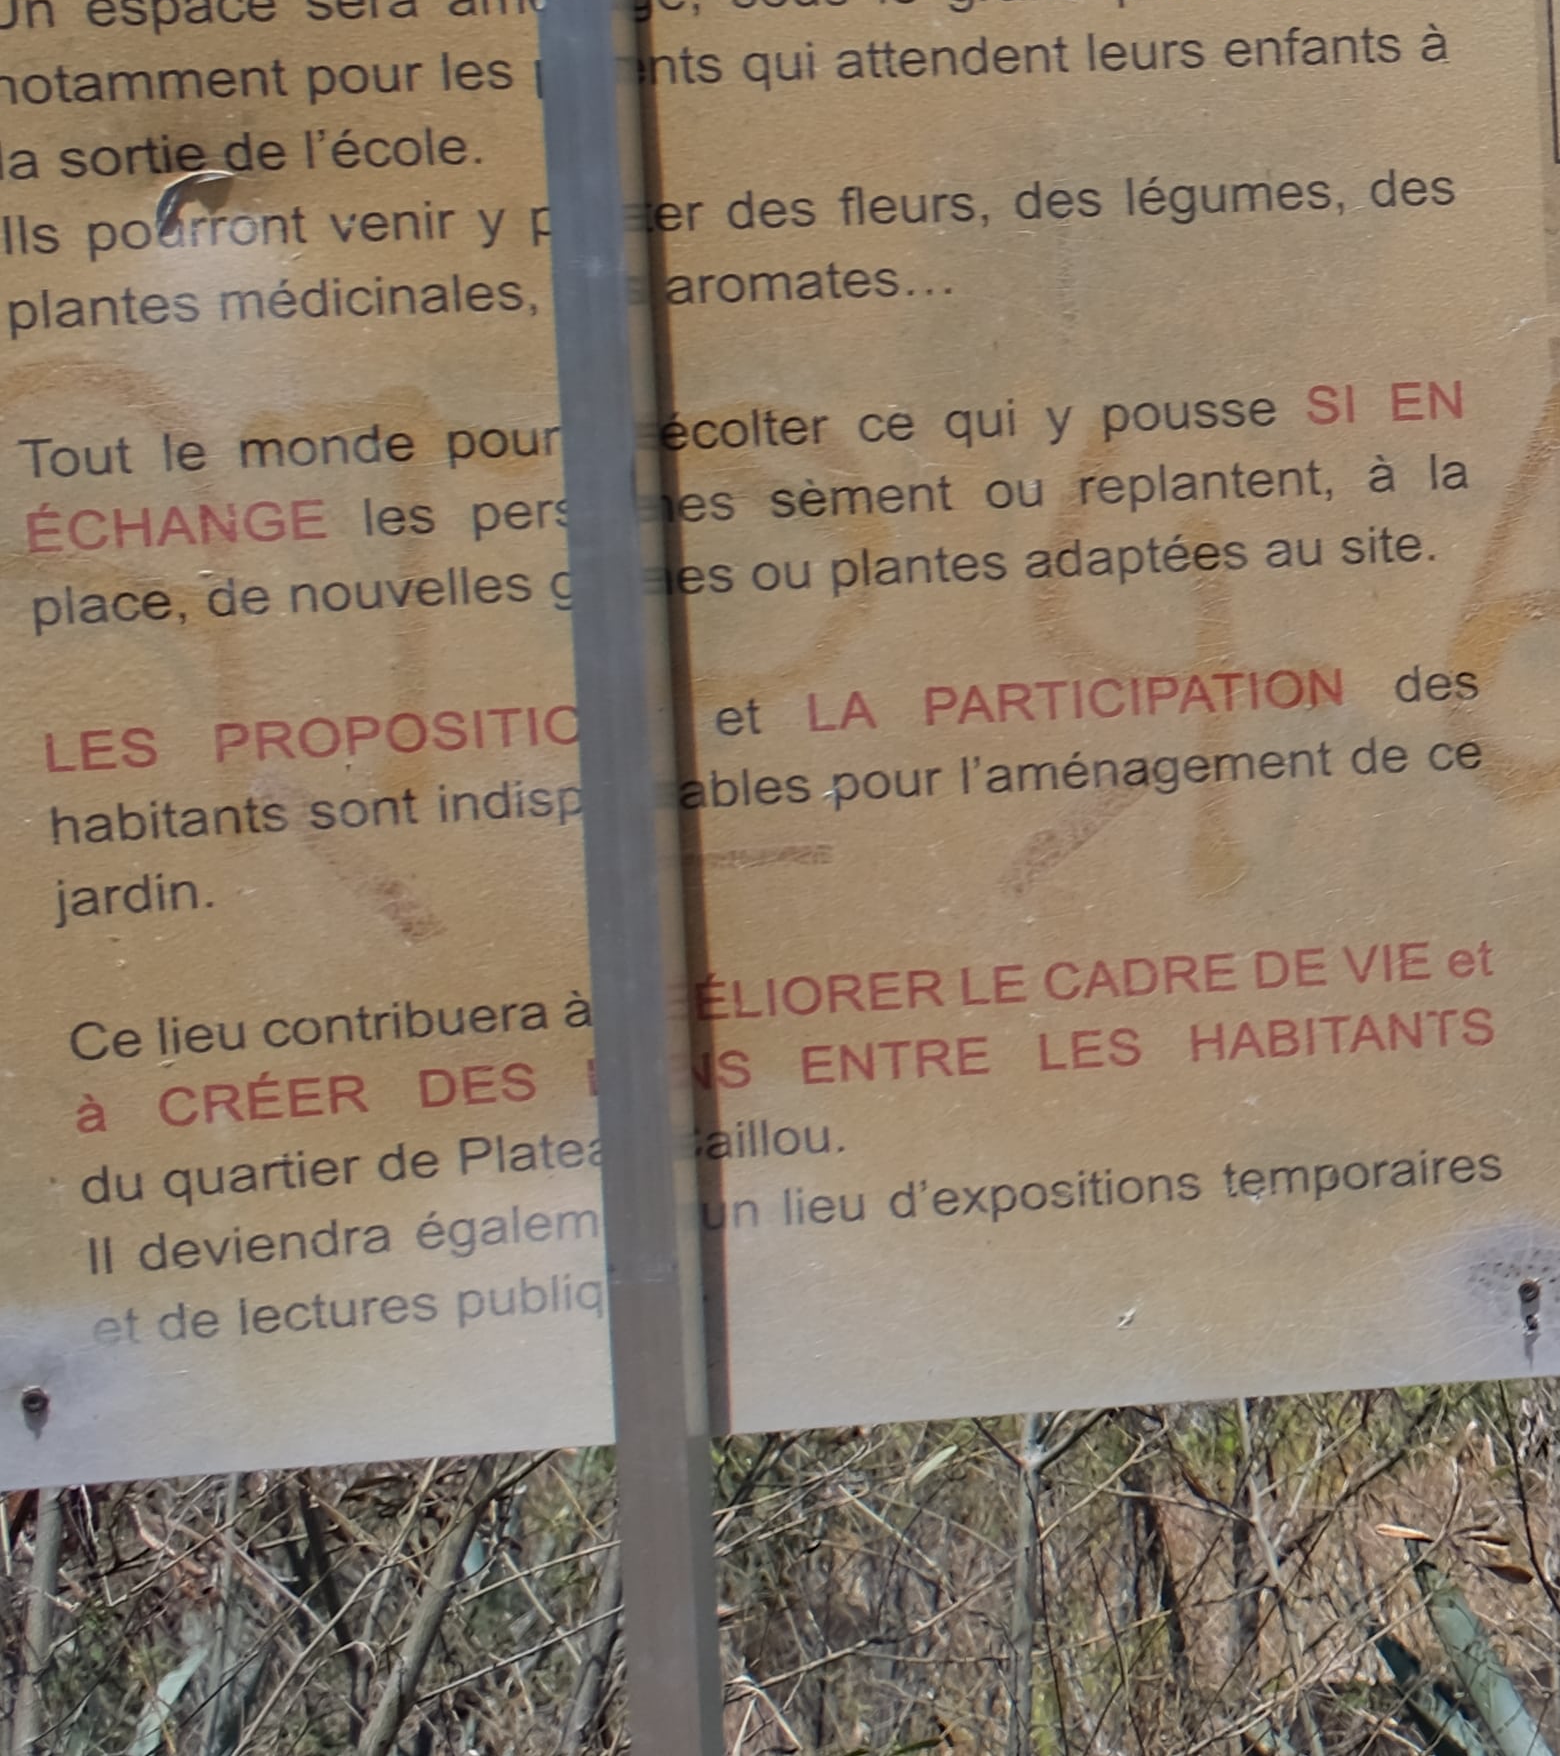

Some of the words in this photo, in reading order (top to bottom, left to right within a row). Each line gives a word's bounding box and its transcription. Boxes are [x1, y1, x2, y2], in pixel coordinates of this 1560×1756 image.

[307, 63, 423, 105] pour
[442, 52, 514, 91] les
[742, 41, 815, 92] qui
[836, 36, 1069, 79] attendent
[1088, 33, 1205, 71] leurs
[1224, 26, 1402, 68] enfants
[1421, 23, 1450, 64] à
[59, 134, 211, 178] sortie
[224, 132, 287, 172] de
[3, 215, 60, 255] Ils
[87, 202, 306, 262] pourront
[330, 201, 456, 243] venir
[478, 208, 505, 249] y
[727, 190, 816, 230] des
[838, 186, 989, 228] fleurs,
[1015, 181, 1102, 219] des
[1126, 176, 1344, 225] légumes,
[1370, 168, 1456, 208] des
[8, 287, 200, 340] plantes
[220, 274, 537, 320] médicinales,
[16, 437, 133, 478] Tout
[163, 432, 206, 471] le
[240, 424, 415, 468] monde
[859, 413, 915, 442] ce
[945, 398, 1016, 448] qui
[1046, 406, 1072, 445] y
[1103, 398, 1276, 443] pousse
[1307, 385, 1354, 425] SI
[1391, 380, 1463, 421] EN
[27, 499, 328, 555] ÉCHANGE
[364, 498, 435, 536] les
[769, 475, 955, 518] sèment
[986, 479, 1043, 509] ou
[1075, 460, 1332, 512] replantent,
[1369, 454, 1395, 493] à
[1430, 453, 1469, 490] la
[33, 583, 187, 636] place,
[202, 574, 270, 617] de
[291, 566, 532, 613] nouvelles
[752, 561, 811, 591] ou
[832, 547, 1007, 597] plantes
[1026, 531, 1248, 585] adaptées
[1266, 538, 1322, 568] au
[1341, 526, 1435, 565] site.
[45, 727, 157, 772] LES
[214, 704, 580, 763] PROPOSITIO
[716, 698, 762, 736] et
[808, 691, 877, 732] LA
[925, 667, 1344, 726] PARTICIPATION
[1395, 665, 1480, 703] des
[50, 797, 288, 845] habitants
[309, 788, 419, 830] sont
[833, 767, 942, 812] pour
[1351, 737, 1408, 775] de
[1428, 734, 1488, 778] ce
[55, 873, 214, 928] jardin.
[70, 1021, 142, 1060] Ce
[158, 1016, 246, 1055] lieu
[263, 1001, 548, 1048] contribuera
[564, 988, 592, 1029] à
[960, 964, 1027, 1005] LE
[1044, 953, 1237, 1000] CADRE
[1255, 948, 1327, 989] DE
[1343, 942, 1431, 984] VIE
[1448, 940, 1493, 978] et
[77, 1093, 107, 1133] à
[159, 1071, 368, 1127] CRÉER
[419, 1062, 536, 1108] DES
[802, 1036, 990, 1084] ENTRE
[1039, 1028, 1142, 1071] LES
[1190, 1007, 1494, 1062] HABITANTS
[81, 1165, 143, 1204] du
[163, 1150, 361, 1207] quartier
[378, 1143, 439, 1182] de
[89, 1236, 113, 1275] Il
[139, 1219, 390, 1271] deviendra
[784, 1188, 865, 1225] lieu
[1223, 1149, 1502, 1201] temporaires
[96, 1308, 138, 1340] et
[159, 1303, 219, 1340] de
[240, 1293, 437, 1335] lectures
